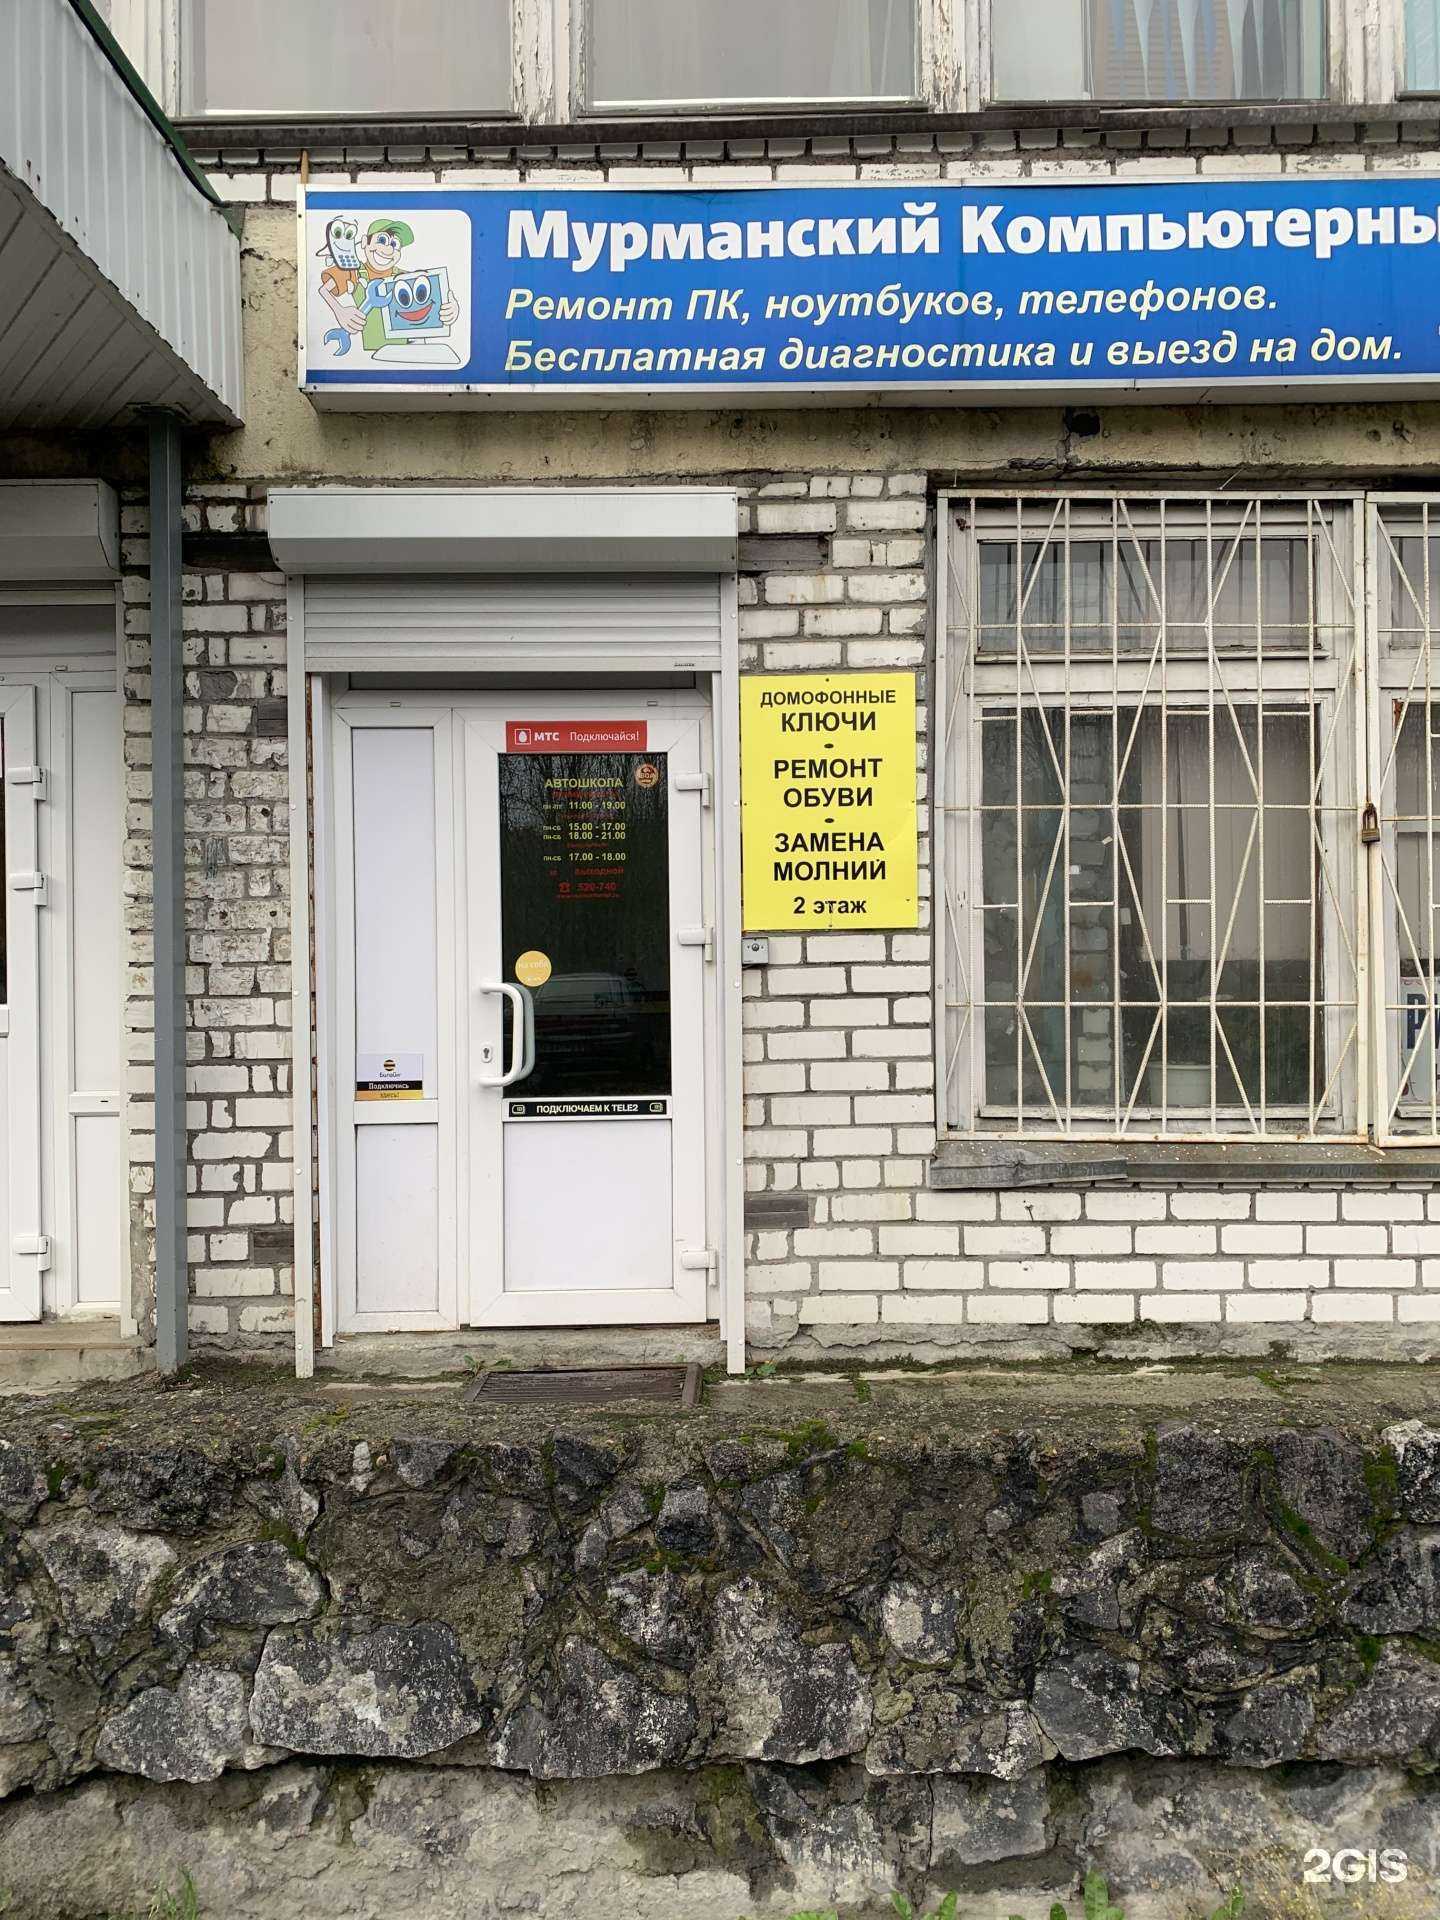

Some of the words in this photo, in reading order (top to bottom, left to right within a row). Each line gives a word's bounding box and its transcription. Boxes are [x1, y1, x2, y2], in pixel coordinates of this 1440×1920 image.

[506, 201, 941, 273] Мурманский
[962, 203, 1440, 259] Компьютерны
[504, 288, 673, 321] Ремонт
[686, 288, 751, 327] ПК,
[765, 283, 1004, 324] ноутбуков,
[1018, 280, 1278, 320] телефонов.
[504, 340, 765, 372] Бесплатная
[779, 336, 1055, 369] диагностика
[1070, 341, 1094, 366] и
[1107, 330, 1238, 366] выезд
[1250, 338, 1296, 363] на
[1310, 328, 1402, 362] дом.
[760, 689, 896, 708] ДОМОФОННЫЕ
[781, 711, 877, 733] КЛЮЧИ
[534, 732, 560, 741] МТС
[570, 731, 640, 742] Подключайся!
[774, 758, 883, 779] РЕМОНТ
[544, 777, 624, 788] АВТОШКОЛА
[568, 802, 593, 810] 11.00
[602, 802, 626, 810] 19.00
[783, 787, 873, 808] ОБУВИ
[568, 822, 593, 830] 15.00
[602, 822, 626, 830] 17.00
[568, 832, 593, 840] 18.00
[602, 832, 626, 840] 21.00
[774, 831, 885, 853] ЗАМЕНА
[568, 853, 593, 861] 17.00
[602, 853, 626, 861] 18.00
[773, 859, 887, 881] МОЛНИЙ
[793, 896, 806, 914] 2
[813, 899, 867, 915] этаж
[536, 1105, 602, 1114] ПОДКЛЮЧАЕМ
[612, 1103, 639, 1112] TELE2
